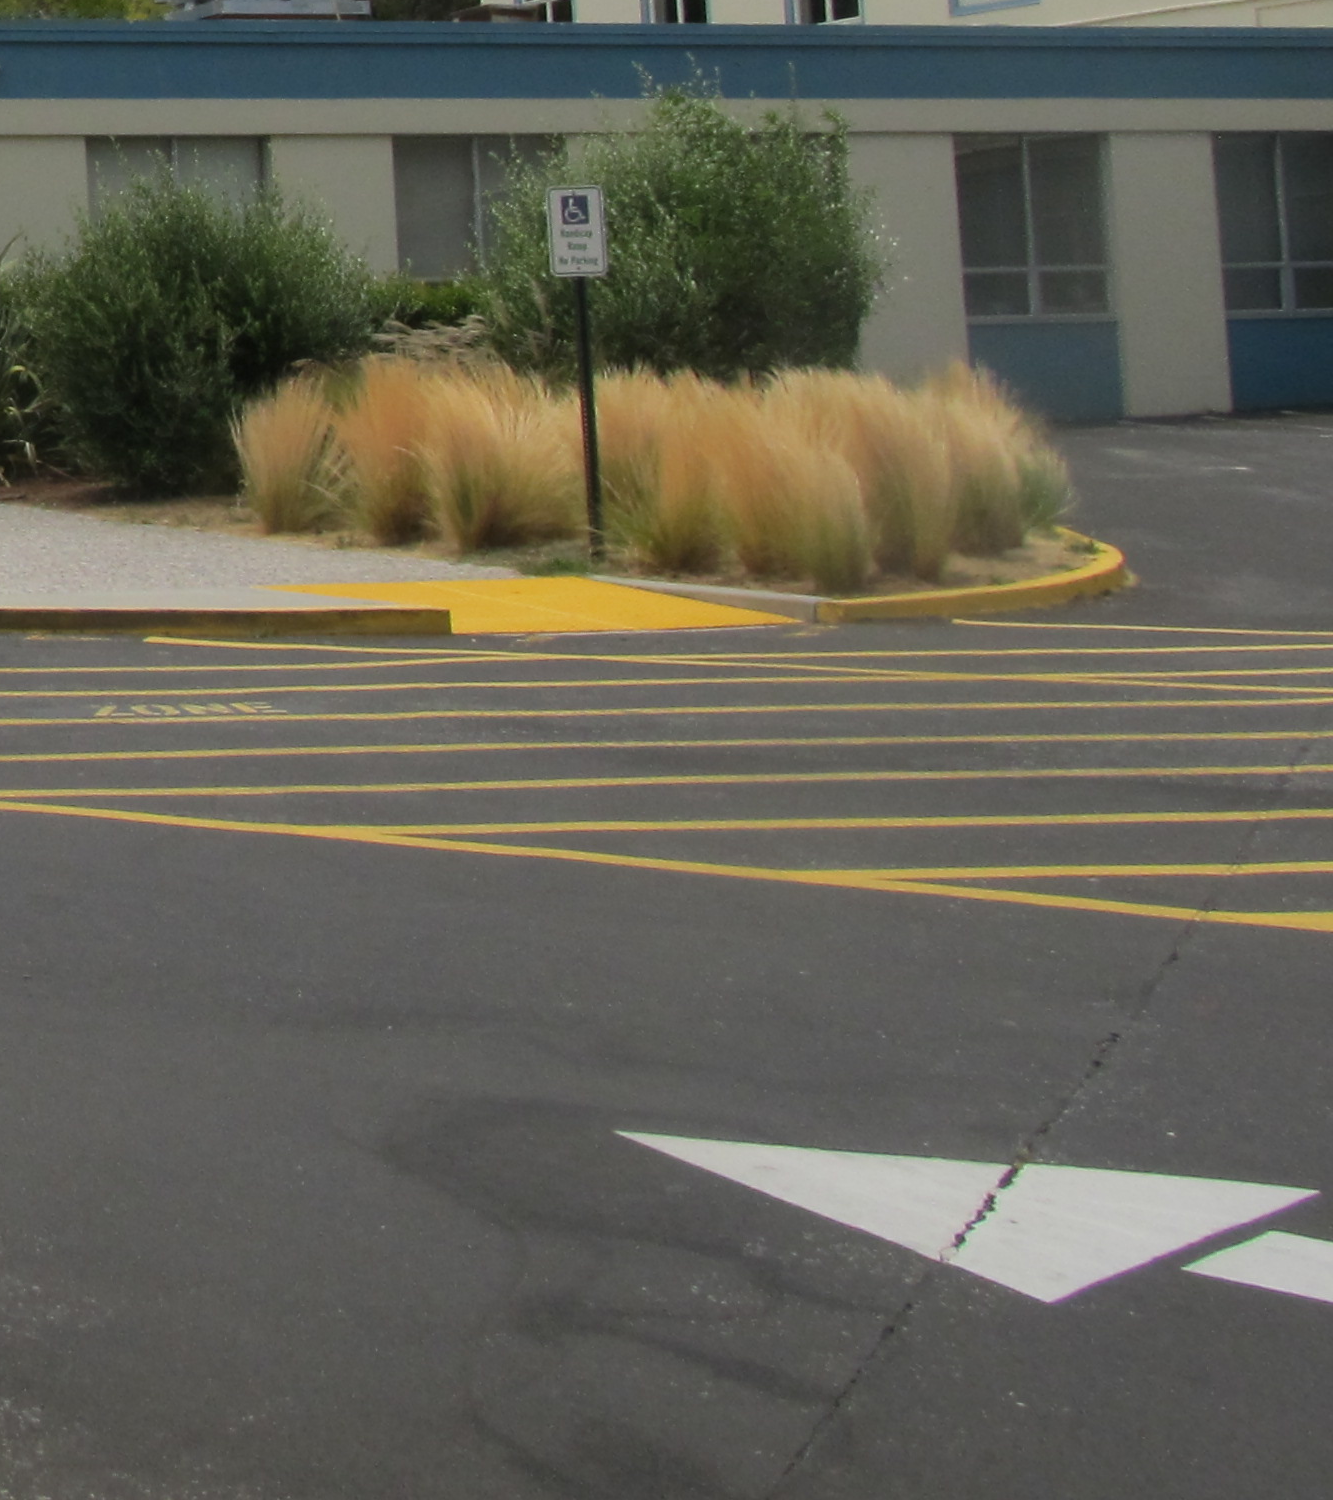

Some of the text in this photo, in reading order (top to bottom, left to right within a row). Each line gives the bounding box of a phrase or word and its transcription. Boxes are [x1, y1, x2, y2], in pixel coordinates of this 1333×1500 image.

[559, 256, 598, 266] No Parking
[91, 702, 287, 717] ZONE
